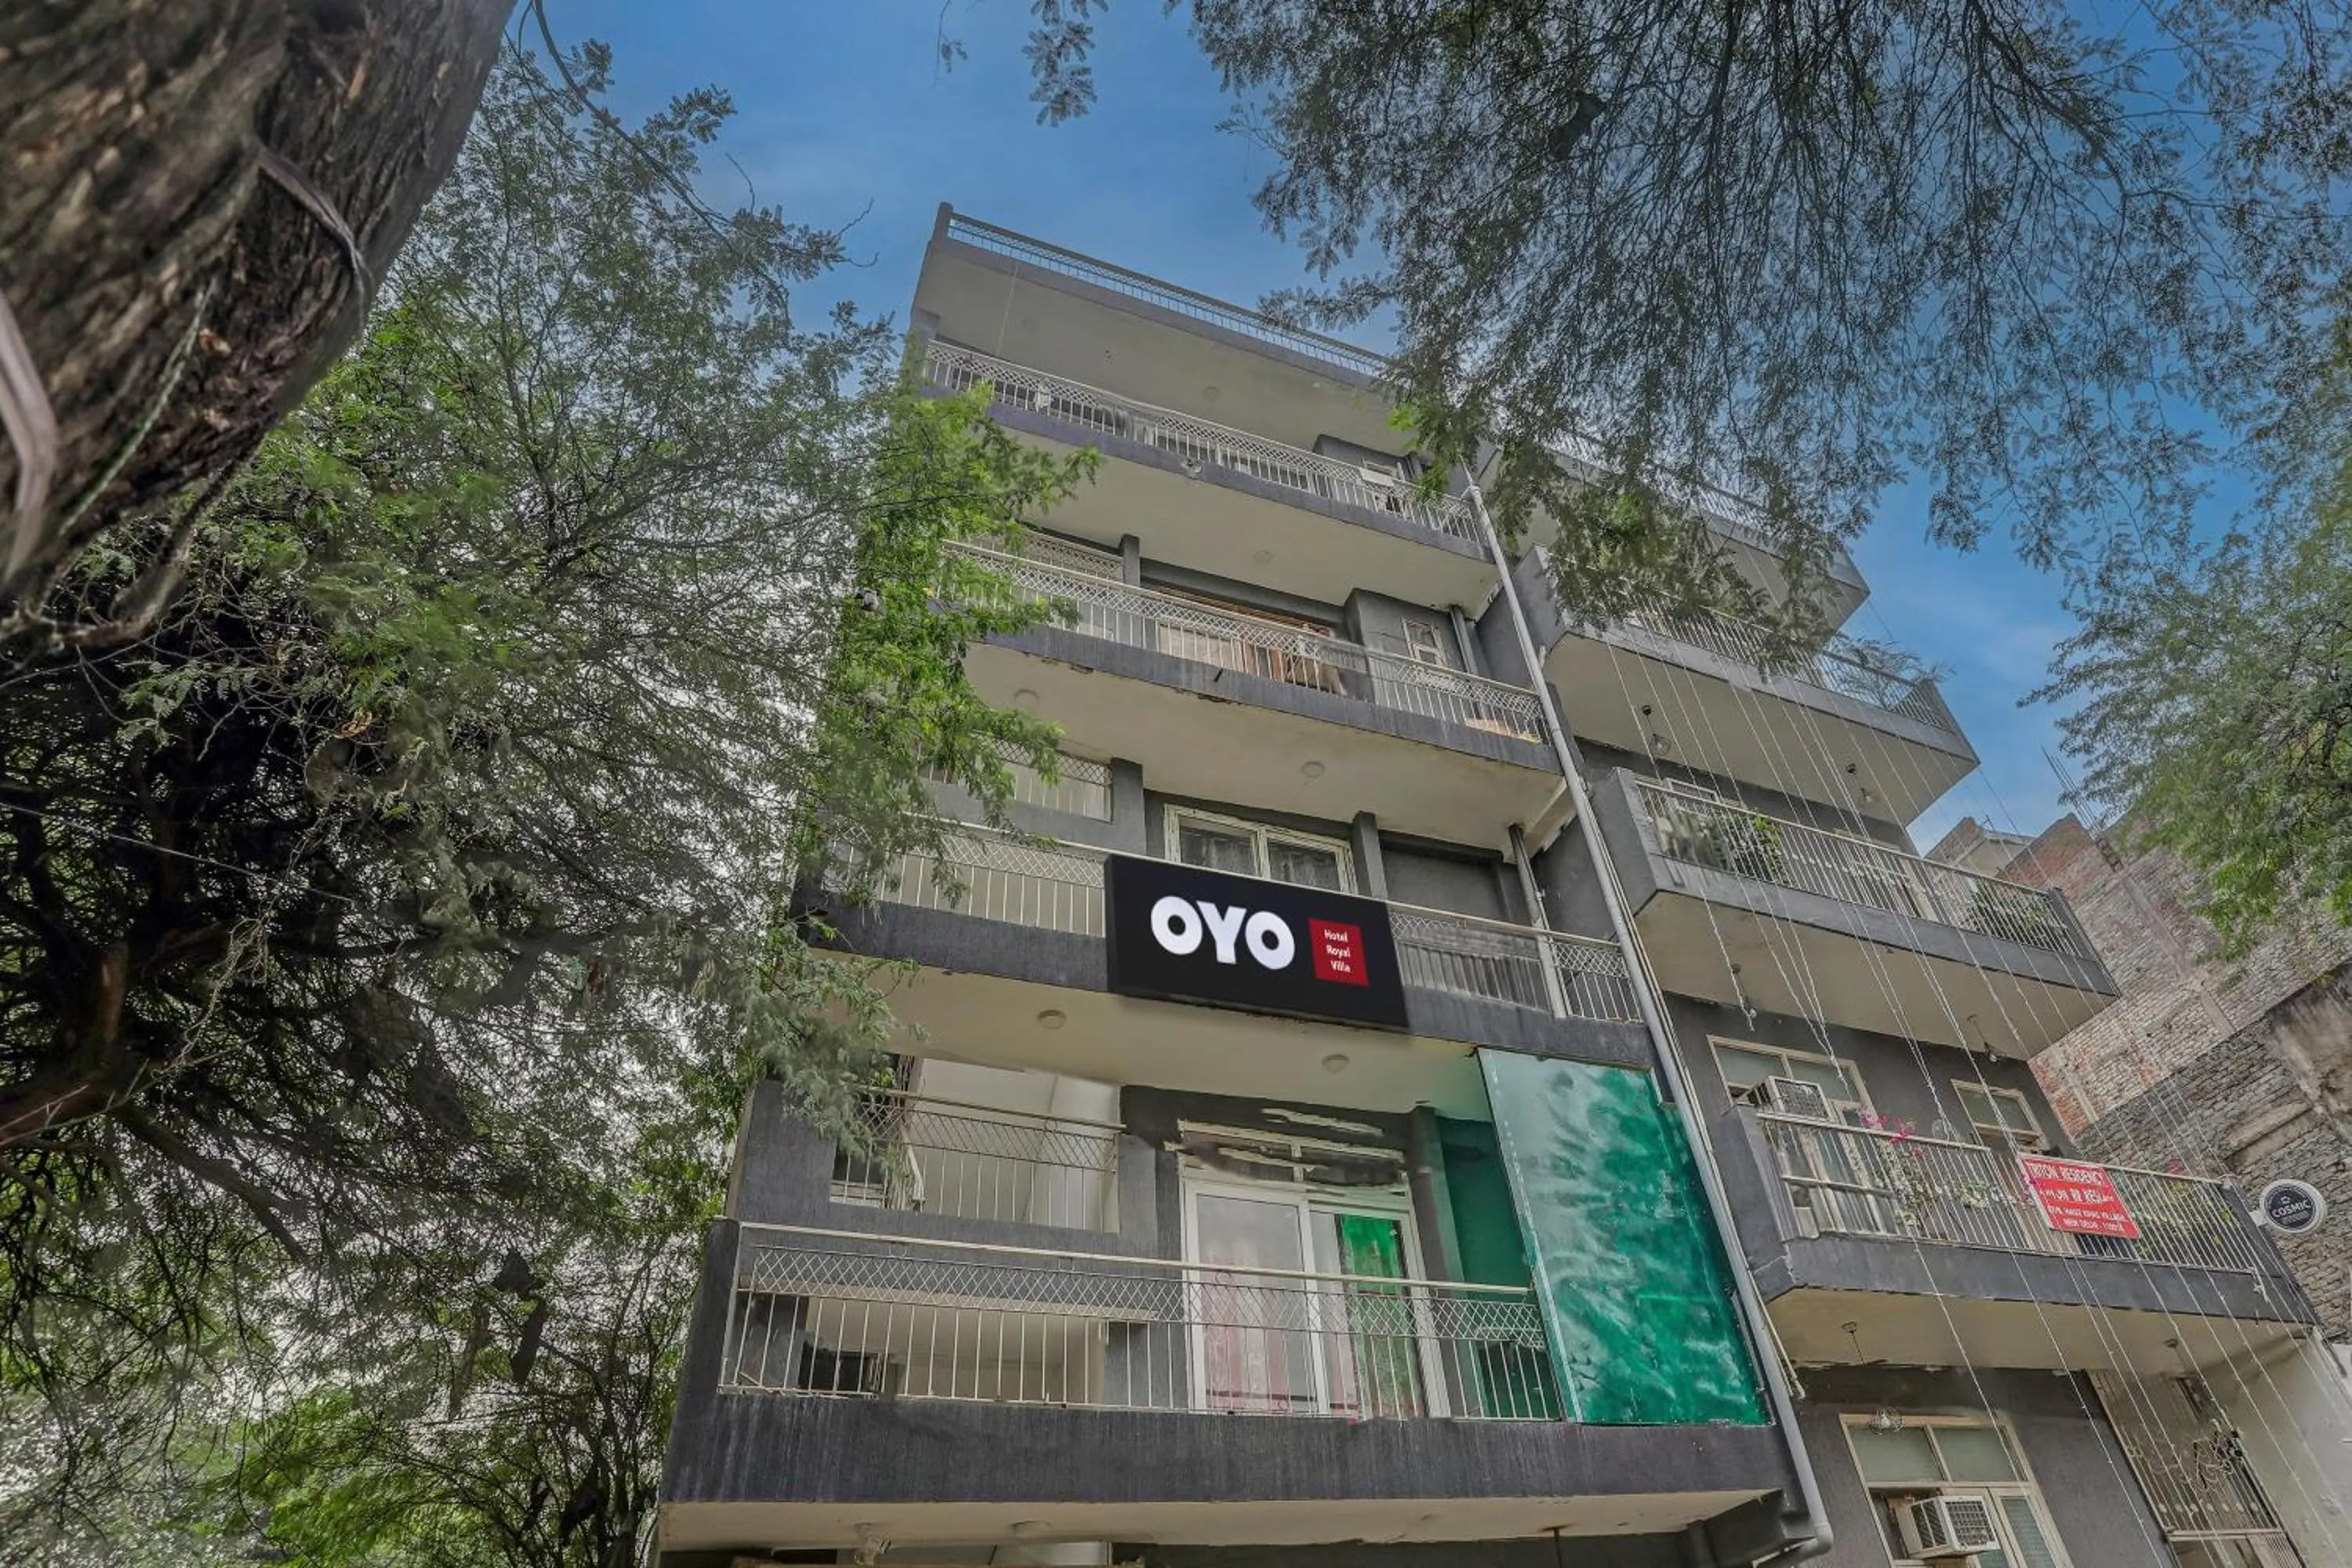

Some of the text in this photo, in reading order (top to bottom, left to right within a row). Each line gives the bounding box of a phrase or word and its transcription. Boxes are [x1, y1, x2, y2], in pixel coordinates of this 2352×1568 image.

[1150, 895, 1295, 970] OYO
[1324, 929, 1348, 942] Hotel
[1326, 945, 1351, 959] Royal
[1330, 960, 1351, 973] Villa
[2272, 1200, 2311, 1218] COSMIC
